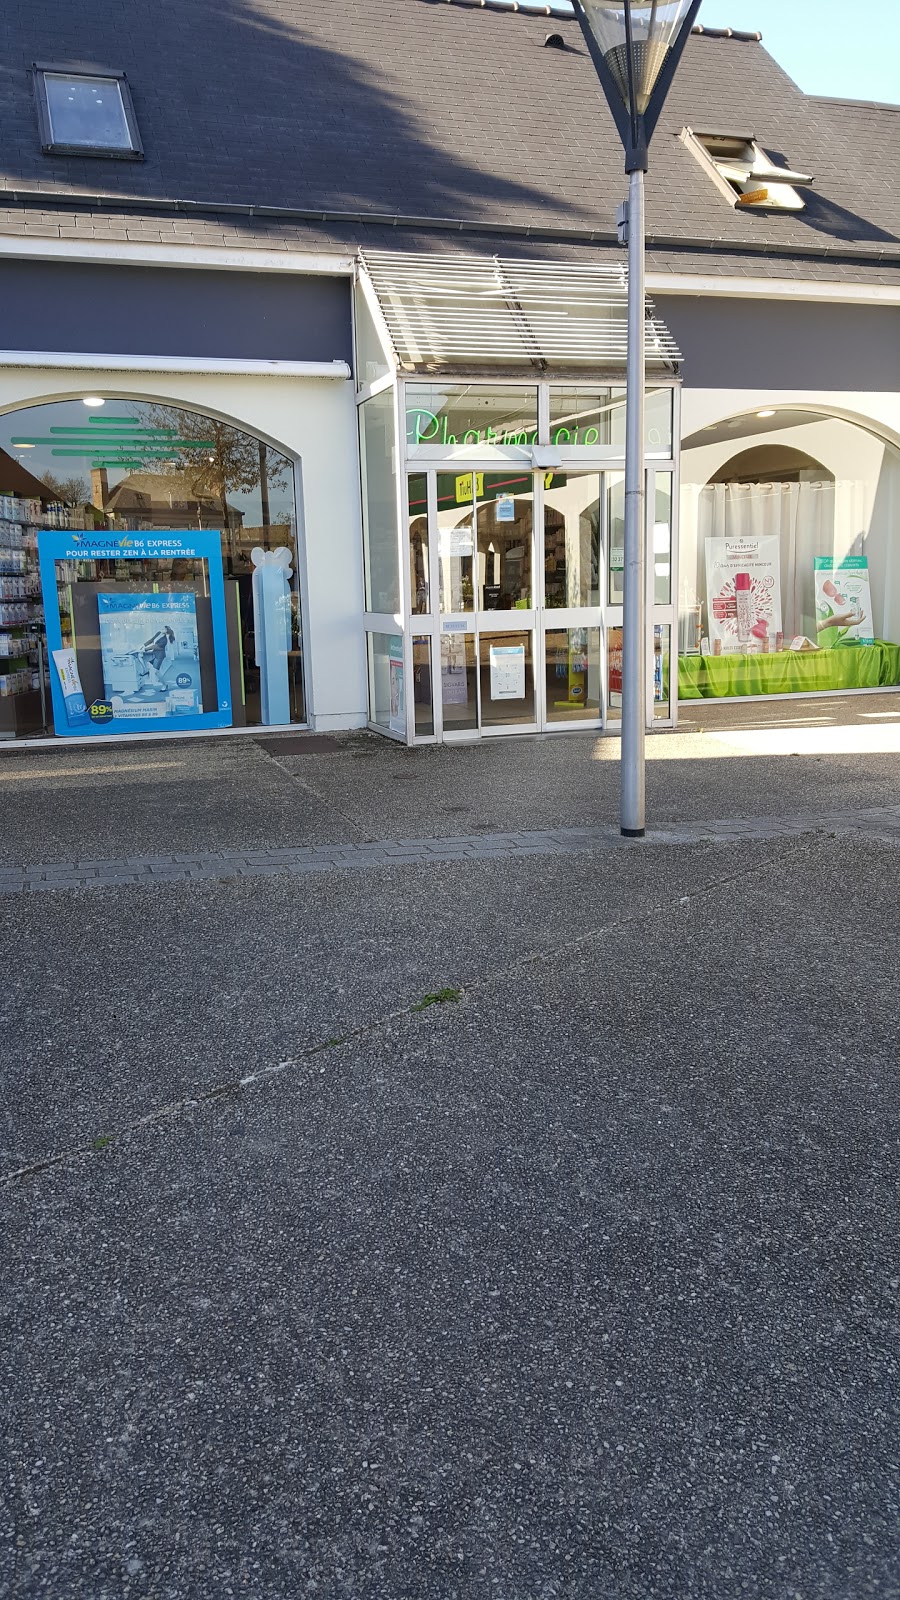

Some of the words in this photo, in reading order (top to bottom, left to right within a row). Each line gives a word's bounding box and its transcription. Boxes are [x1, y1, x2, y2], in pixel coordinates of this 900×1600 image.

[134, 540, 145, 548] B6
[147, 539, 182, 548] EXPRESS
[725, 541, 759, 550] Puressentiel
[90, 549, 121, 557] RESTER
[140, 547, 147, 556] À
[160, 548, 196, 556] RENTRÉE
[90, 704, 113, 715] 89%
